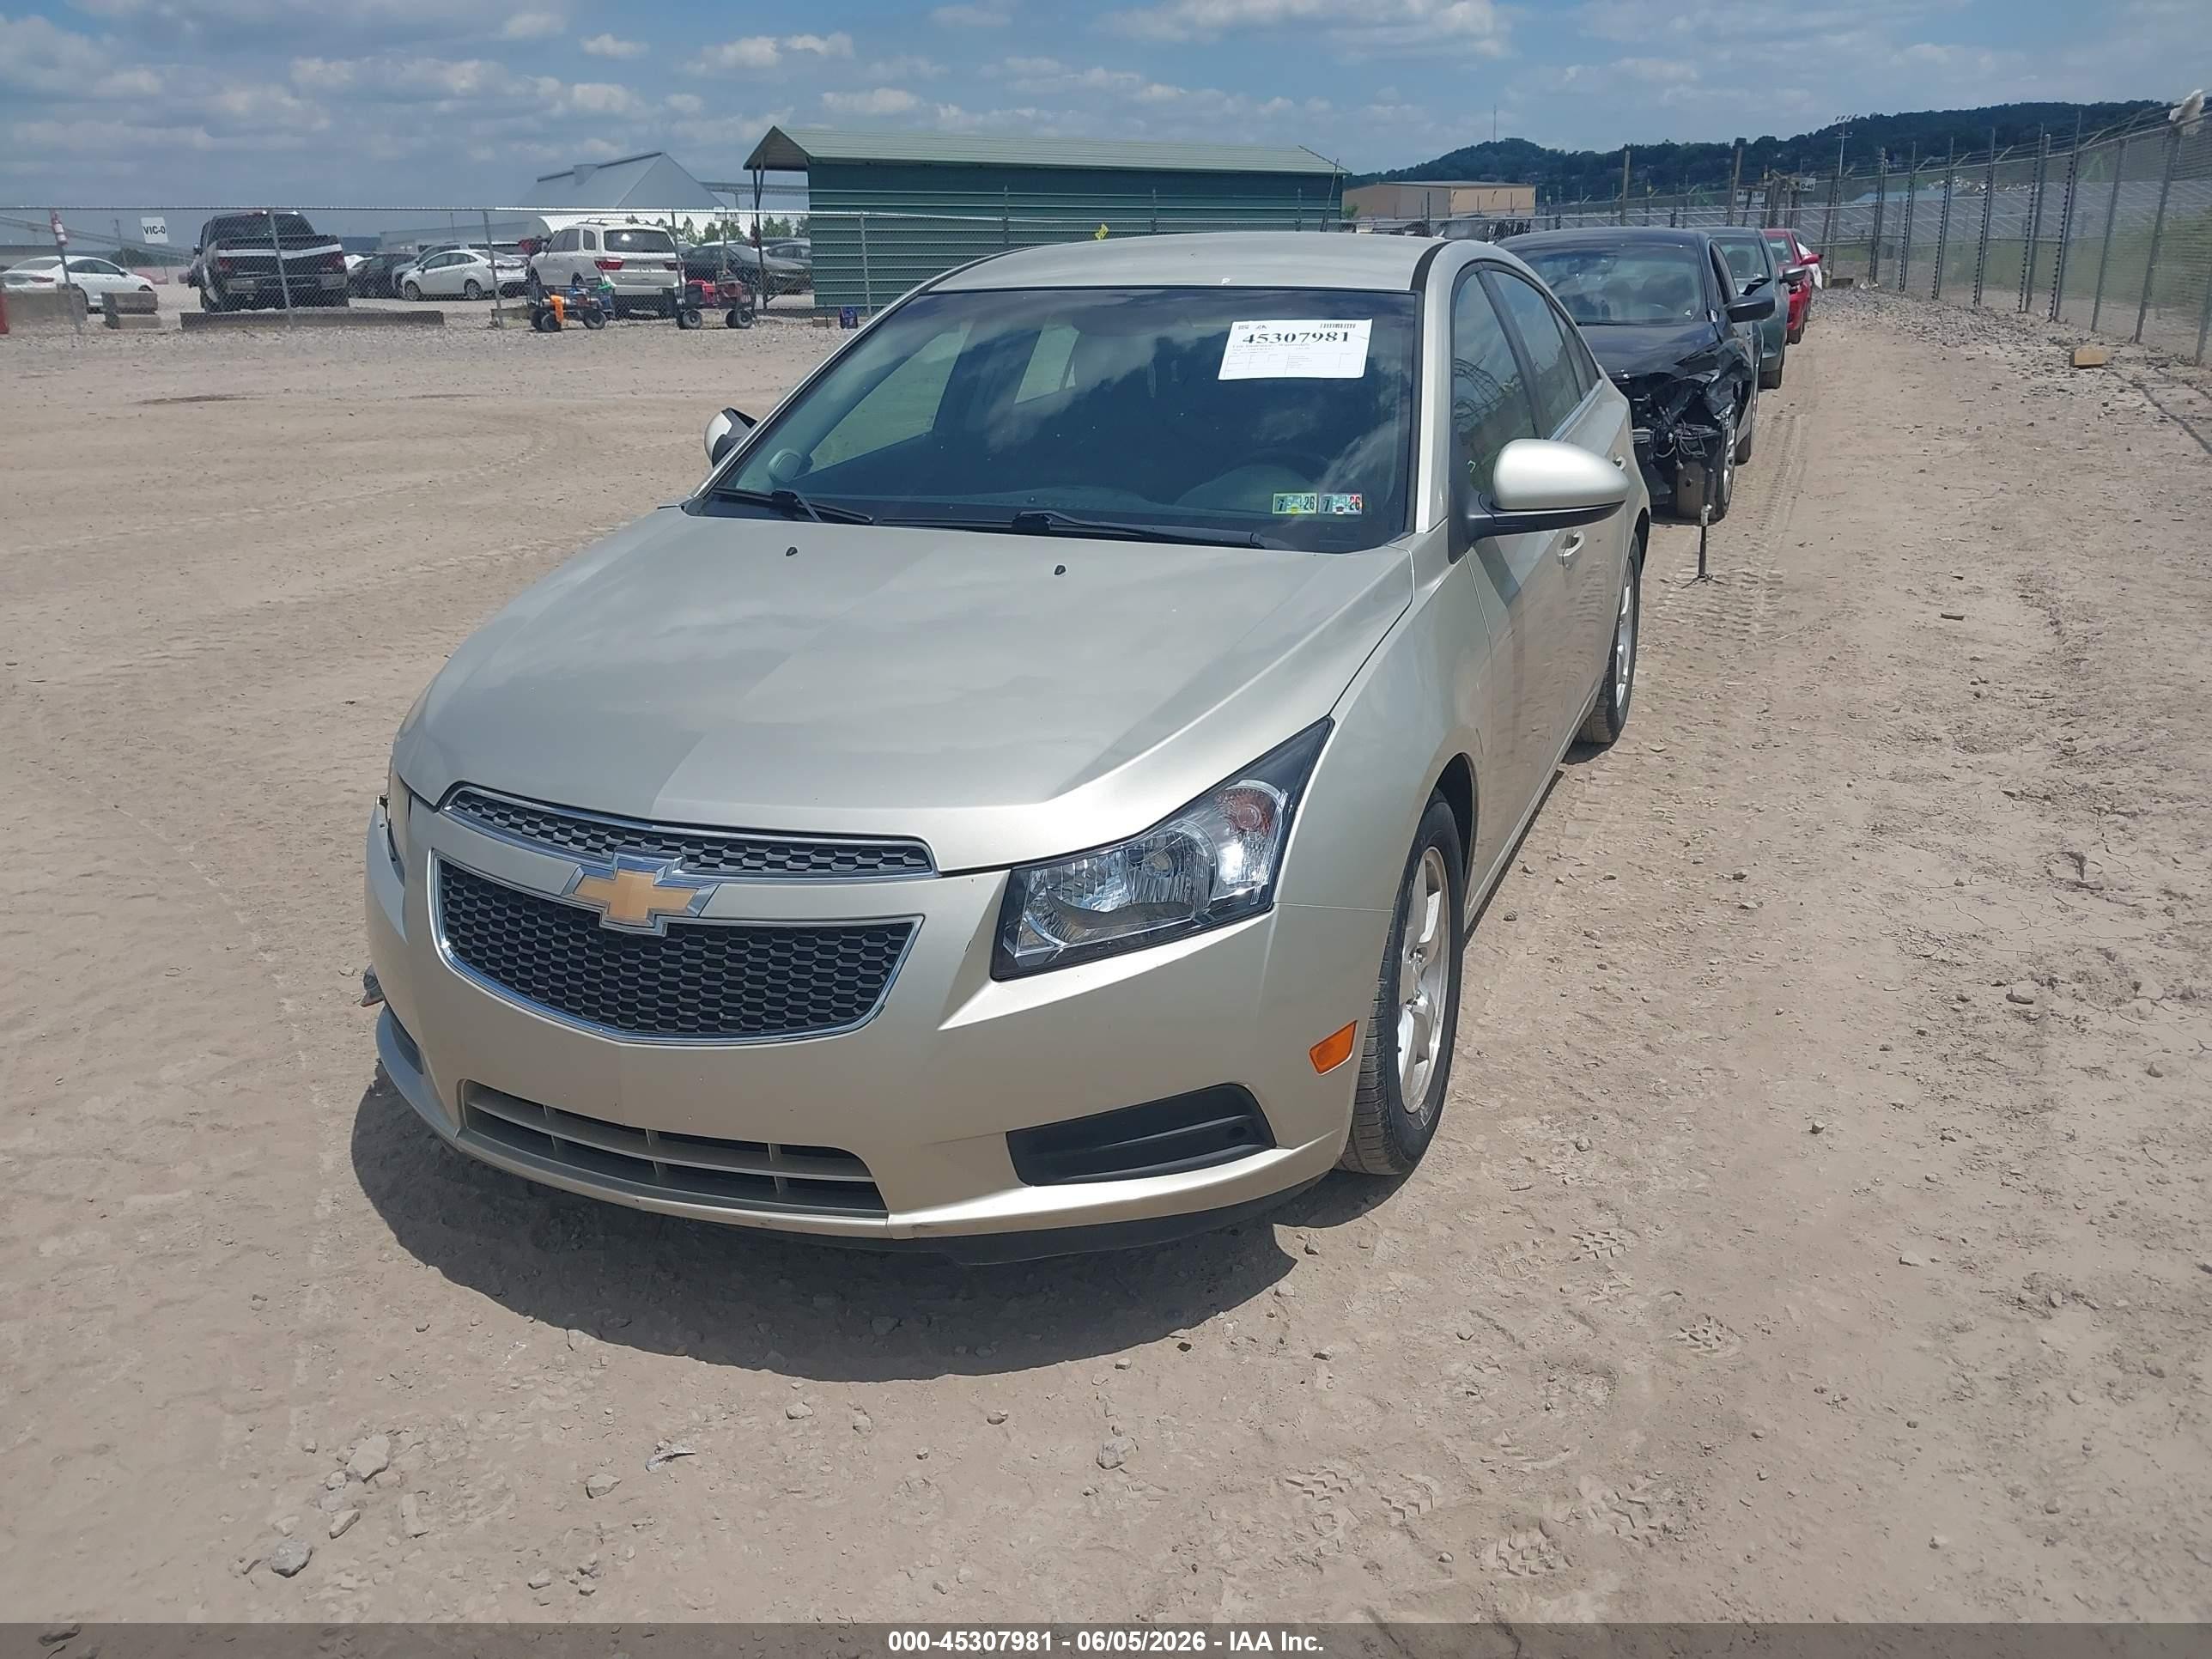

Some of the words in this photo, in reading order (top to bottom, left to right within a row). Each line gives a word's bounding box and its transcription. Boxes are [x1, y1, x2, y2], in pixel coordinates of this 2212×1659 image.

[1243, 331, 1349, 344] 45307981
[1277, 499, 1285, 511] 7
[1304, 495, 1315, 510] 26
[1322, 499, 1330, 512] 7
[1349, 495, 1361, 510] 26
